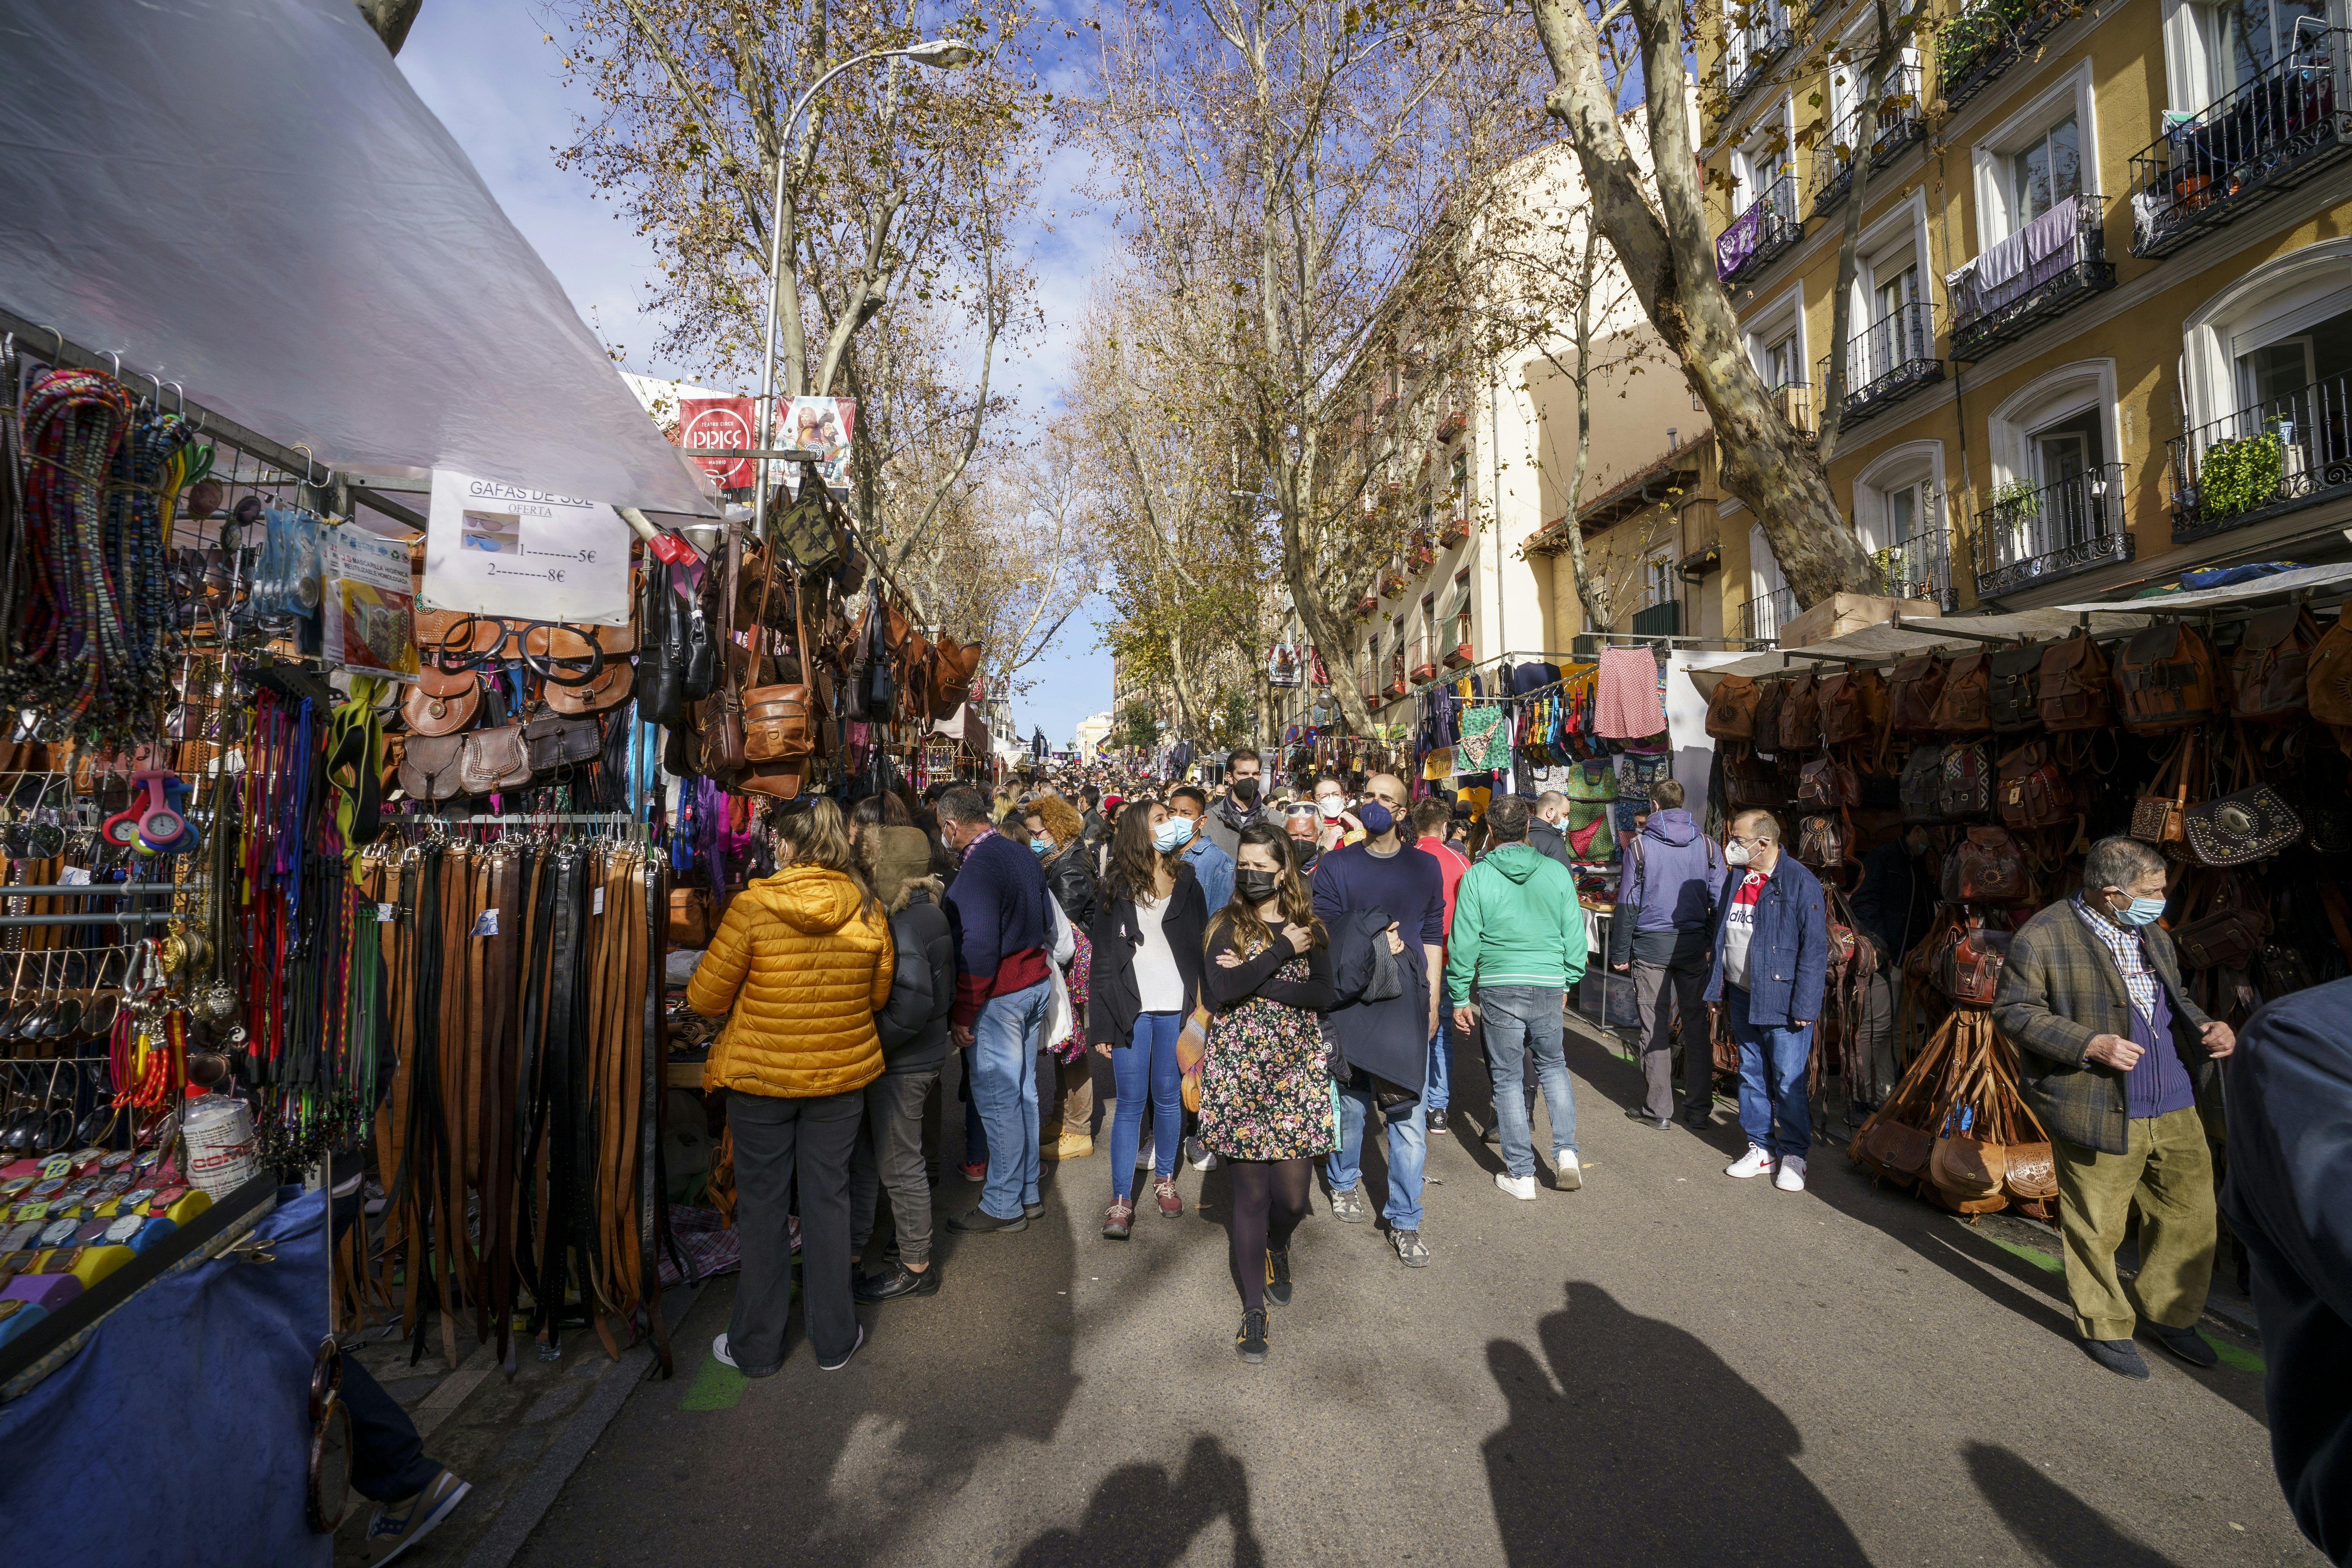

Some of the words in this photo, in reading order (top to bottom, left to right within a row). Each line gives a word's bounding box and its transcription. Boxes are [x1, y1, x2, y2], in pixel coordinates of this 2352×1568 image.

[694, 430, 741, 449] PRICE
[470, 481, 526, 499] GAFAS
[532, 489, 555, 502] DE
[508, 504, 552, 516] OFERTA
[362, 543, 375, 551] UNE
[352, 557, 383, 572] MASCARILLA
[344, 563, 378, 576] REUTILIZABLE
[377, 573, 408, 584] HOMOLOGADA
[479, 911, 495, 922] 6€
[1728, 910, 1754, 924] dida
[192, 1140, 254, 1169] COME
